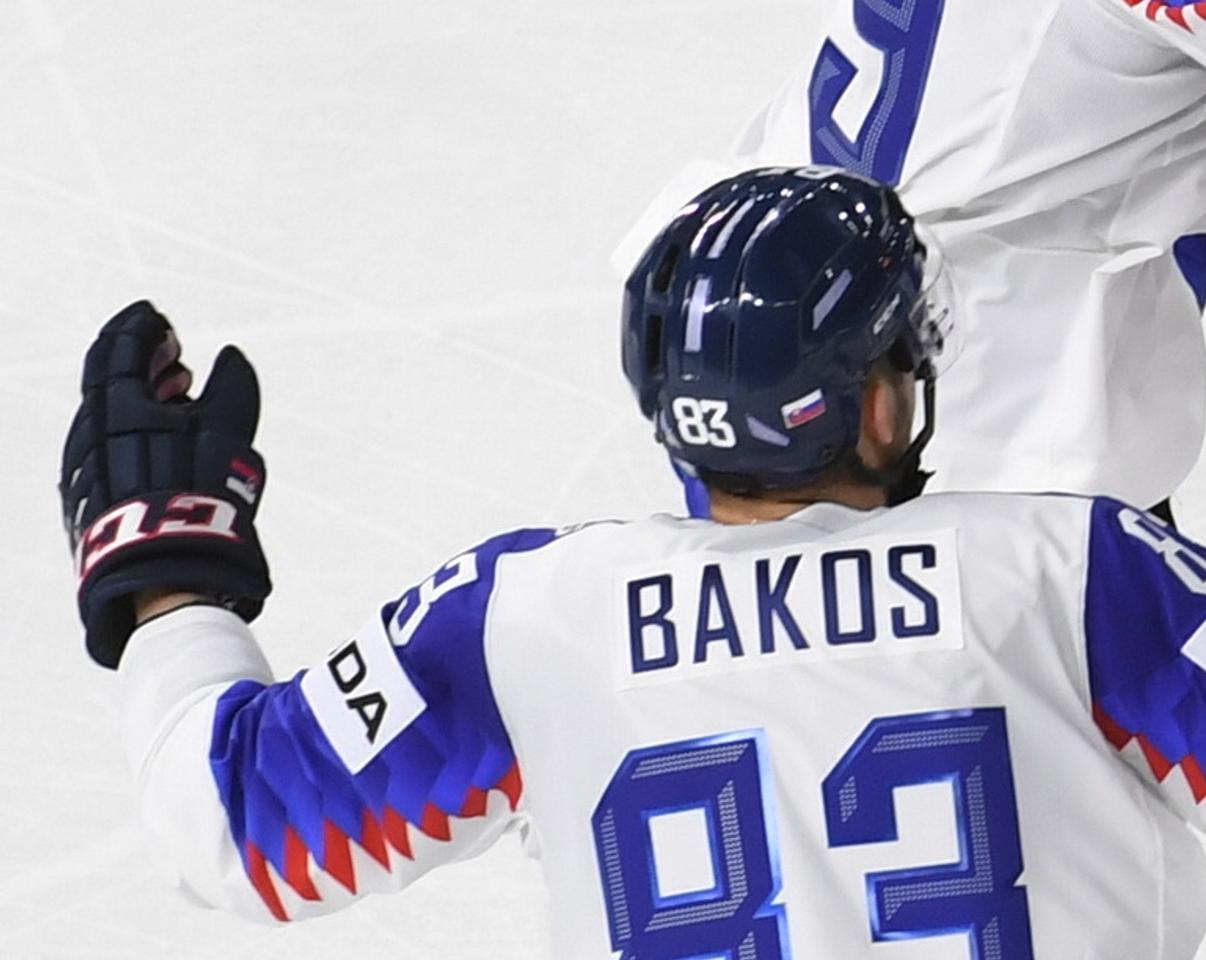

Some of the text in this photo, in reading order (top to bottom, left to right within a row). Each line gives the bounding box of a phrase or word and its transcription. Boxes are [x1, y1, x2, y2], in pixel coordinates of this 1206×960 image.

[671, 396, 737, 449] 83
[627, 543, 941, 675] BAKOS
[327, 639, 389, 745] DA
